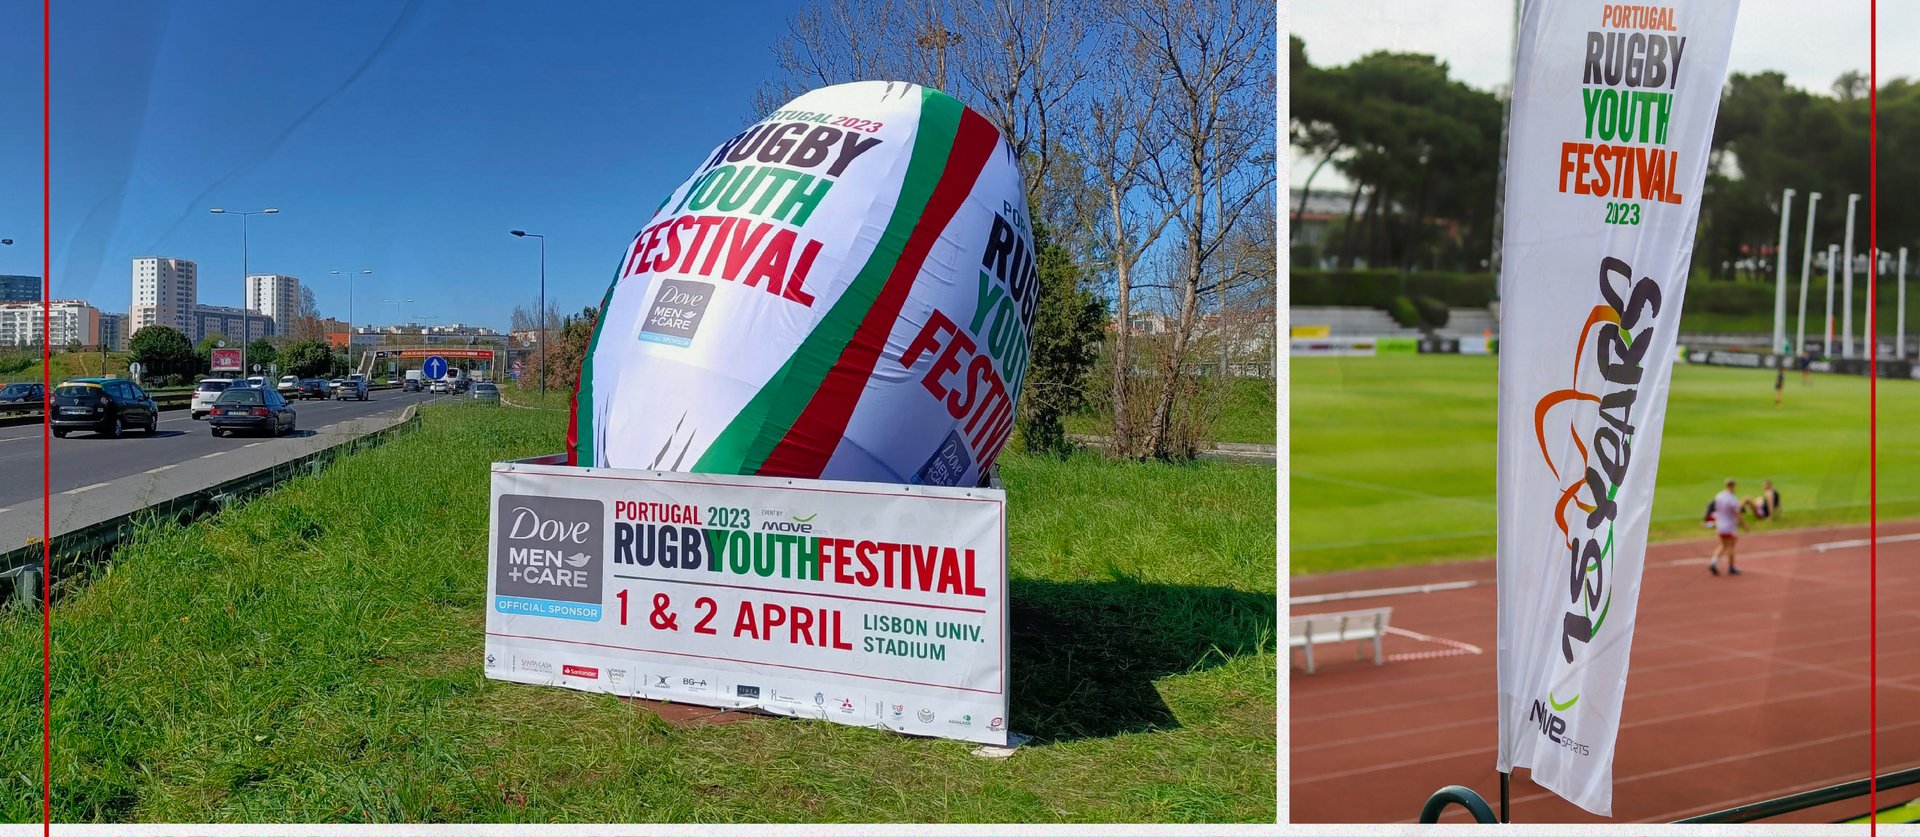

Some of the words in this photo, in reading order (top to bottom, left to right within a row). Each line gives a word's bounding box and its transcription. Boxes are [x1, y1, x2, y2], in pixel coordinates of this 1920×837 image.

[1602, 4, 1677, 32] PORTUGAL
[1583, 31, 1686, 90] RUGBY
[830, 116, 883, 133] 2023
[1582, 88, 1674, 145] YOUTH
[702, 122, 885, 178] RUGBY
[1558, 142, 1683, 205] FESTIVAL
[671, 165, 835, 228] YOUTH
[1605, 201, 1641, 226] 2023
[623, 215, 825, 308] FESTIVAL
[659, 285, 704, 308] Dove
[650, 316, 691, 331] +CARE
[654, 306, 684, 319] MEN
[932, 457, 950, 481] MEN
[942, 439, 963, 477] Dove
[509, 507, 590, 544] Dove
[615, 500, 702, 525] PORTUGAL
[707, 506, 751, 529] 2023
[509, 547, 562, 568] MEN
[508, 567, 588, 588] +CARE
[499, 601, 545, 612] OFFICIAL
[549, 605, 598, 617] SPONSOR
[616, 589, 628, 626] 1
[649, 592, 678, 632] &
[694, 597, 718, 635] 2
[733, 600, 853, 651] APRIL
[863, 613, 928, 637] LISBON
[935, 621, 985, 643] UNIV.
[863, 636, 946, 661] STADIUM
[570, 668, 598, 678] Santander
